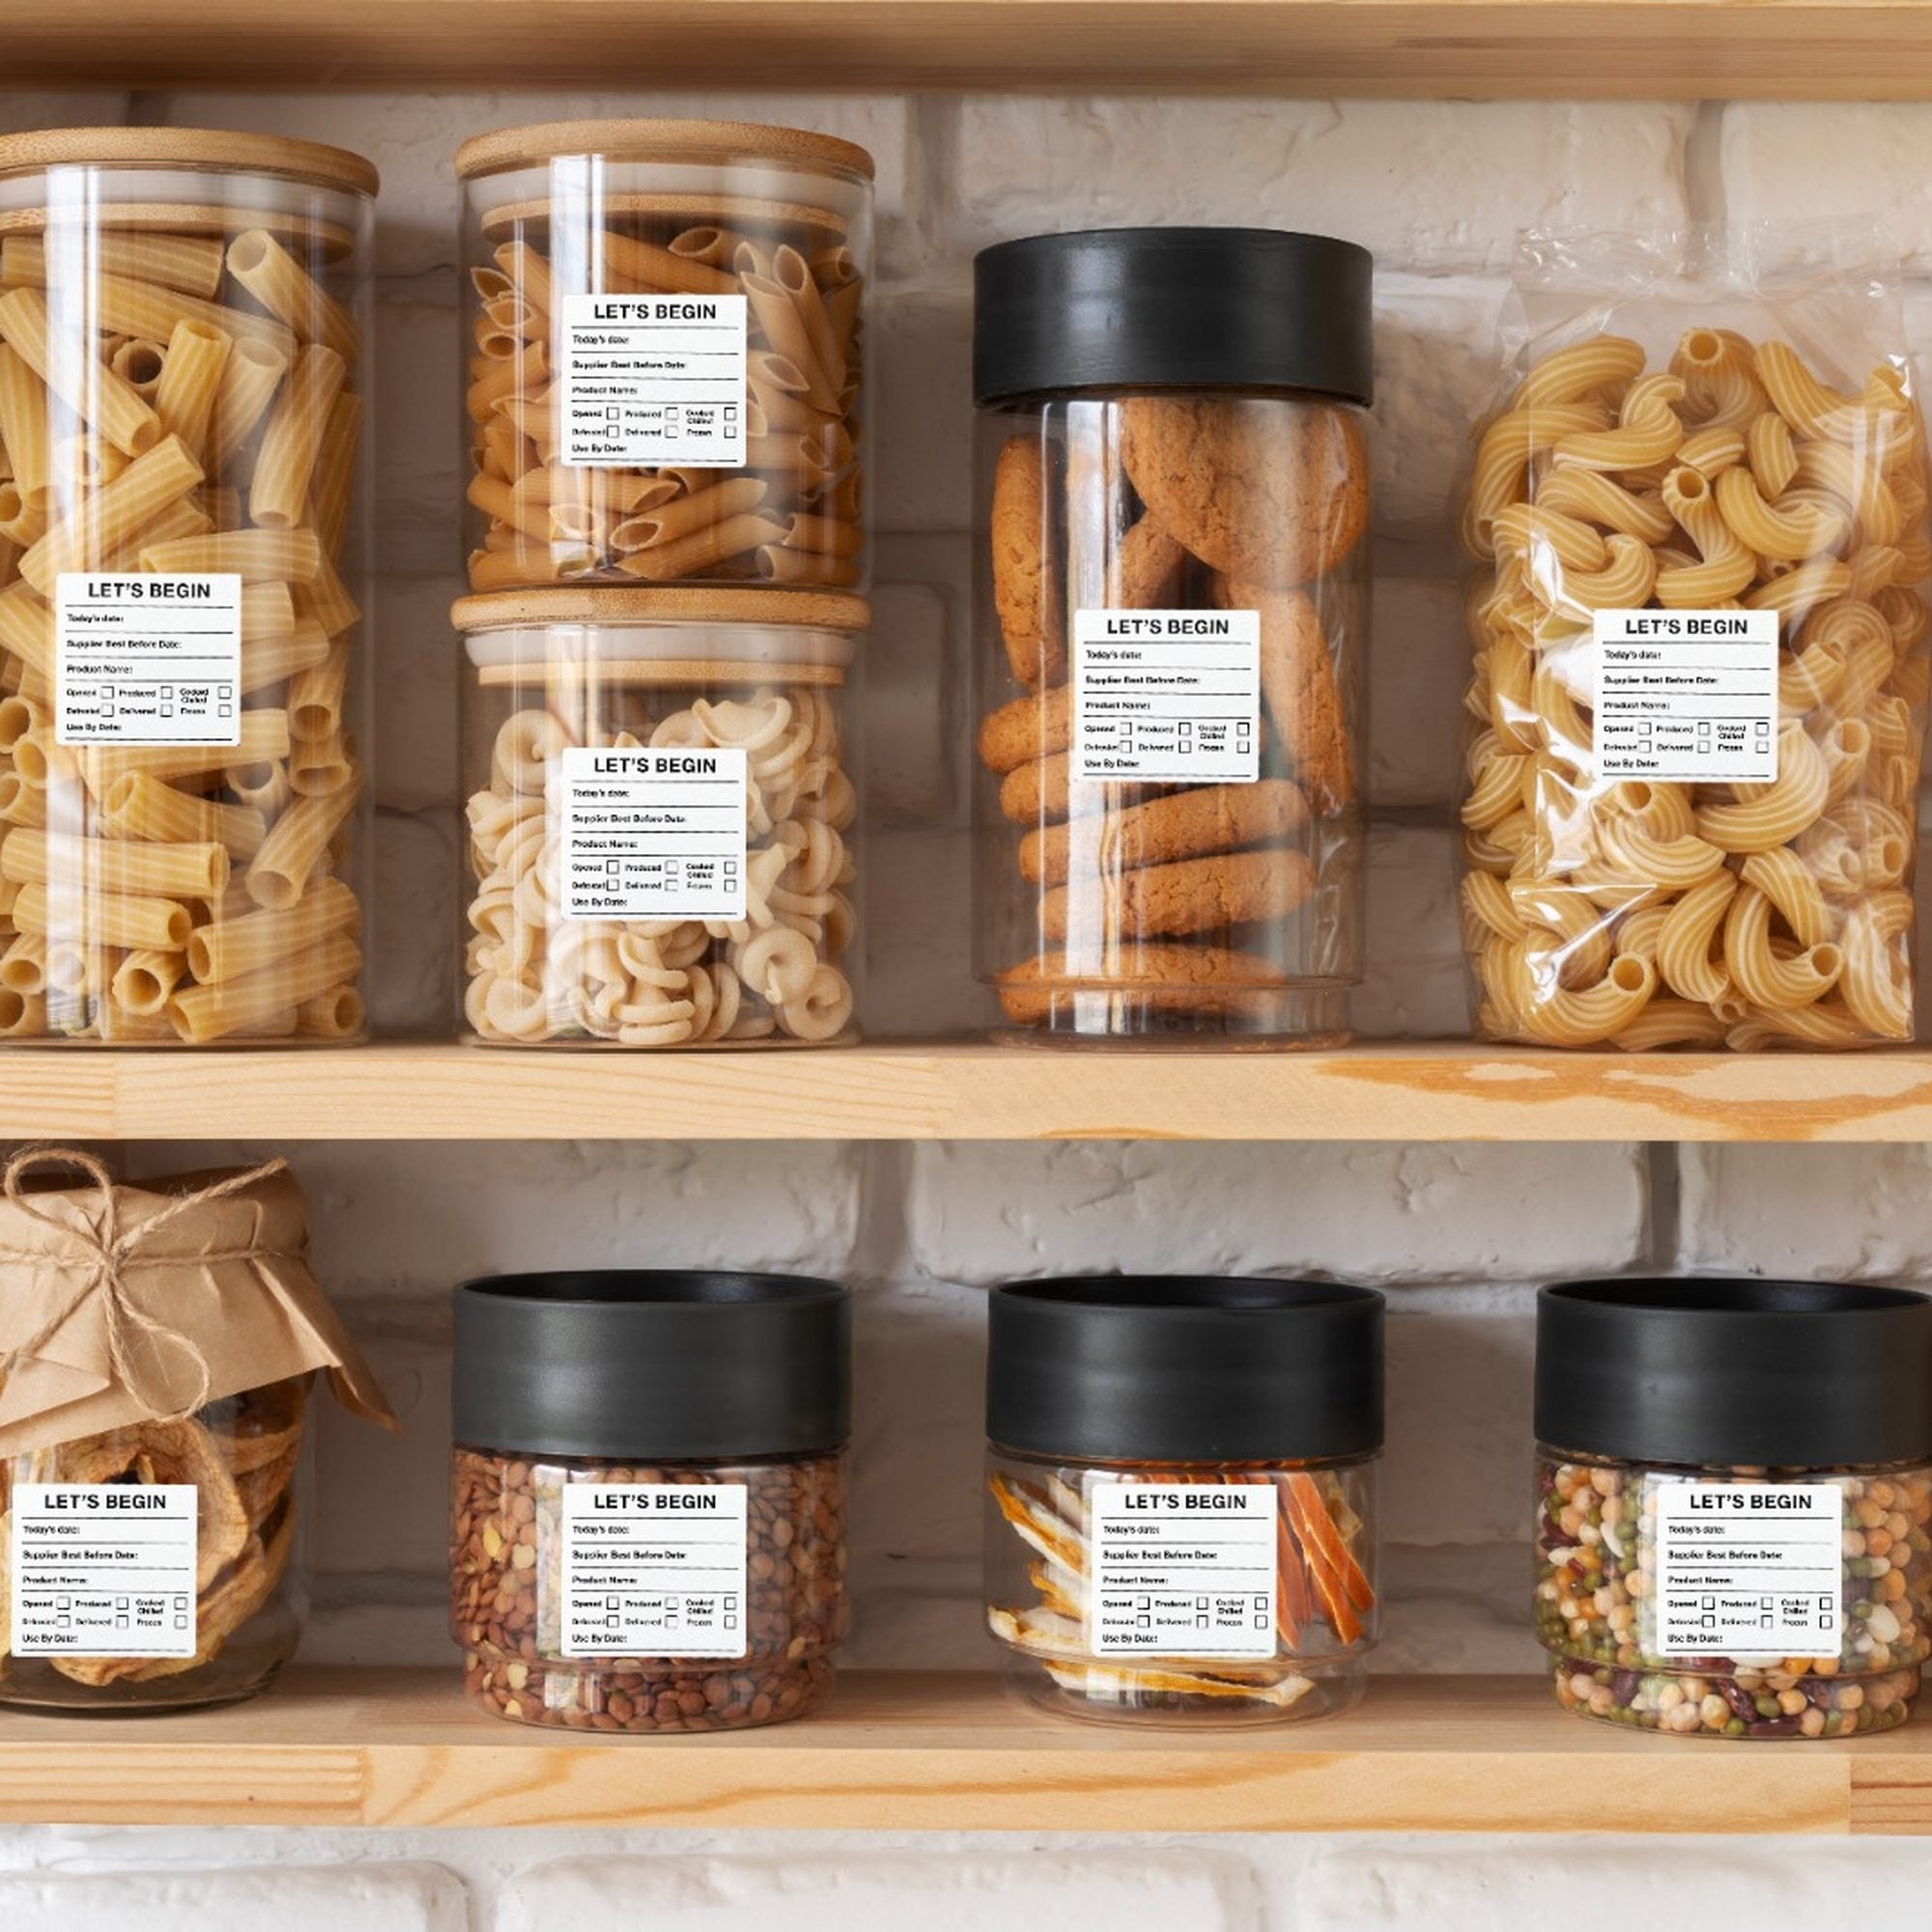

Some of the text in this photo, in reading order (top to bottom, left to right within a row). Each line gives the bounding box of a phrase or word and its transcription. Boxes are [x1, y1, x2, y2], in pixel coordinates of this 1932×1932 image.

[594, 304, 716, 320] LET'S BEGIN
[89, 582, 211, 598] LET'S BEGIN
[1107, 619, 1229, 635] LET'S BEGIN
[1626, 619, 1747, 635] LET'S BEGIN
[594, 757, 716, 774] LET'S BEGIN
[44, 1493, 166, 1509] LET'S BEGIN
[594, 1493, 716, 1509] LET'S BEGIN
[1125, 1494, 1246, 1509] LET'S BEGIN
[1690, 1493, 1811, 1509] LET'S BEGIN
